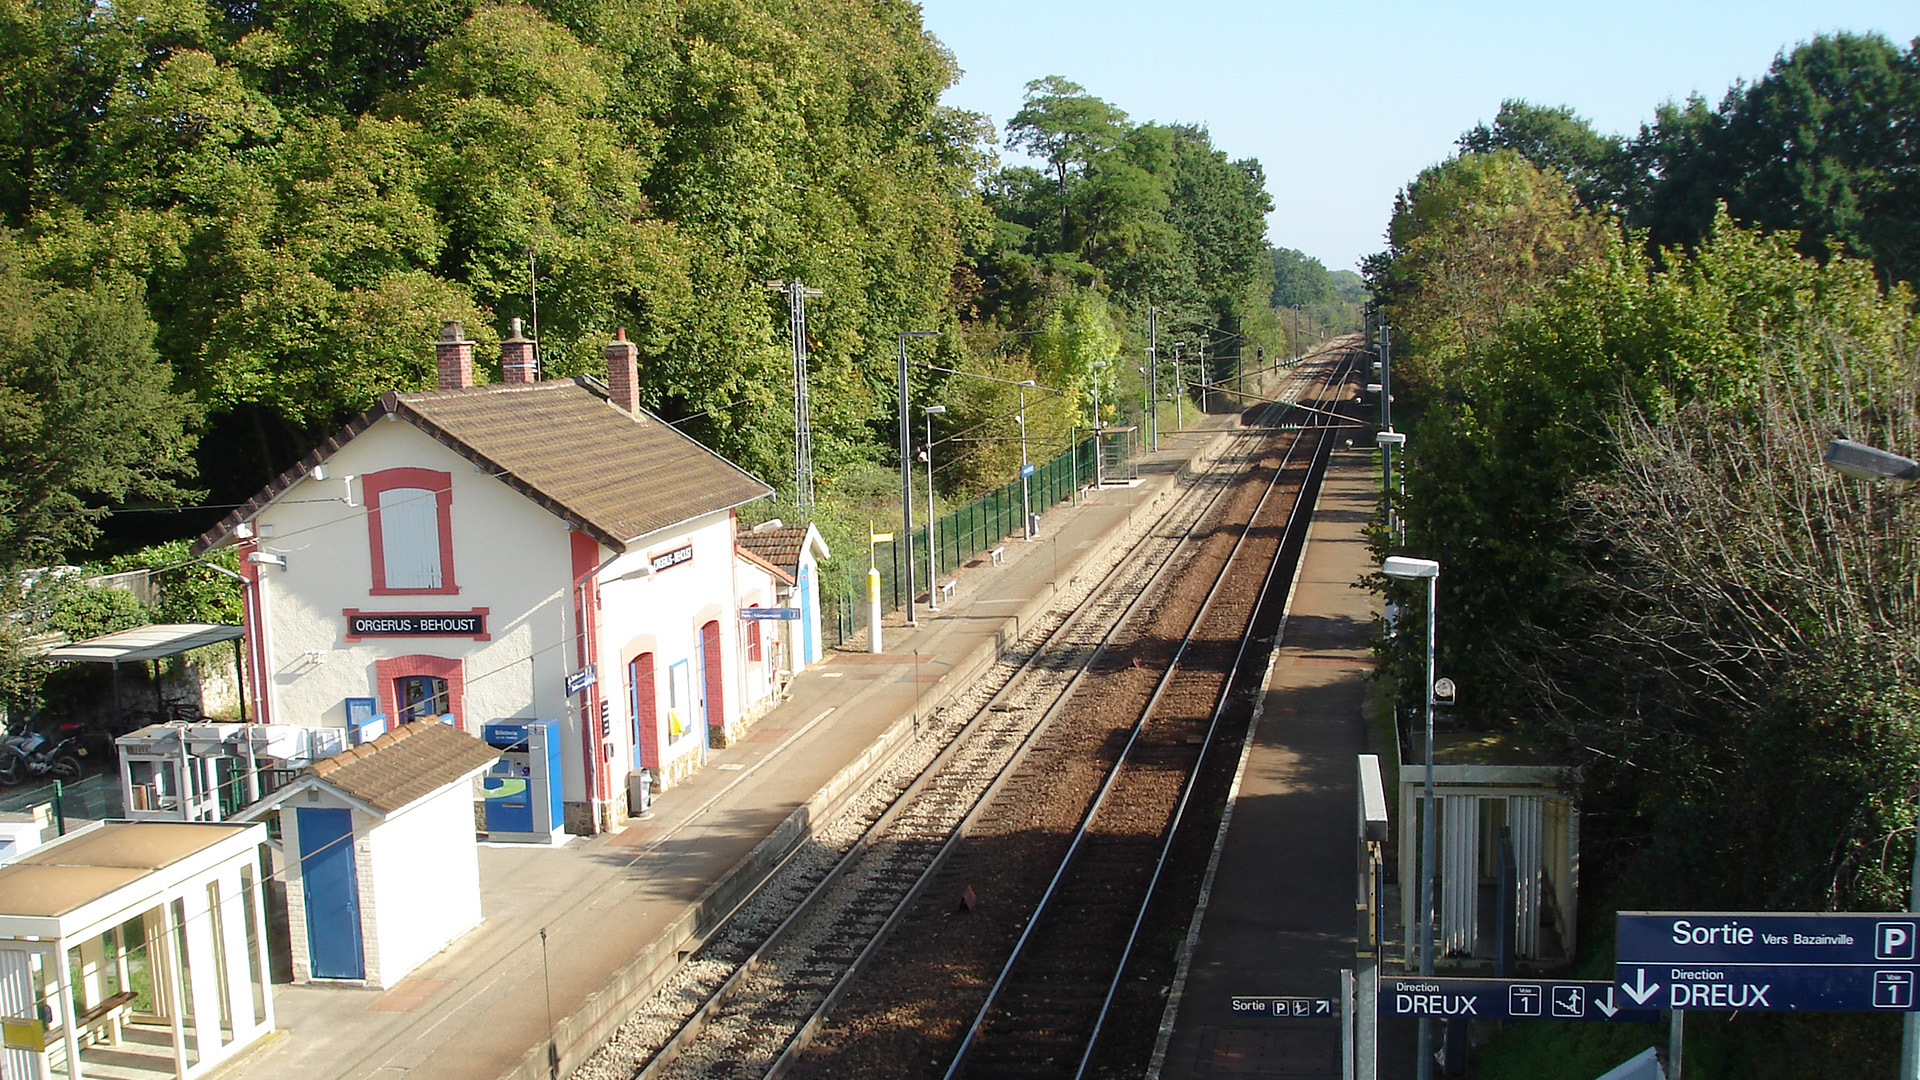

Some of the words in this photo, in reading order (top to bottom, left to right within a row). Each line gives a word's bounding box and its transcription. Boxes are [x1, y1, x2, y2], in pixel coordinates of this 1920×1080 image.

[355, 619, 411, 632] ORGERUS
[420, 618, 475, 631] BEHOUST
[1672, 920, 1754, 945] Sortie
[1761, 933, 1789, 945] Vers
[1793, 933, 1854, 945] Bazainville
[1884, 928, 1906, 954] P
[1671, 968, 1724, 980] Direction
[1396, 982, 1440, 992] Direction
[1670, 983, 1771, 1007] DREUX
[1888, 984, 1897, 1004] 1
[1232, 1000, 1265, 1011] Sortie
[1276, 1003, 1285, 1014] P
[1396, 994, 1478, 1015] DREUX
[1521, 996, 1528, 1013] 1
